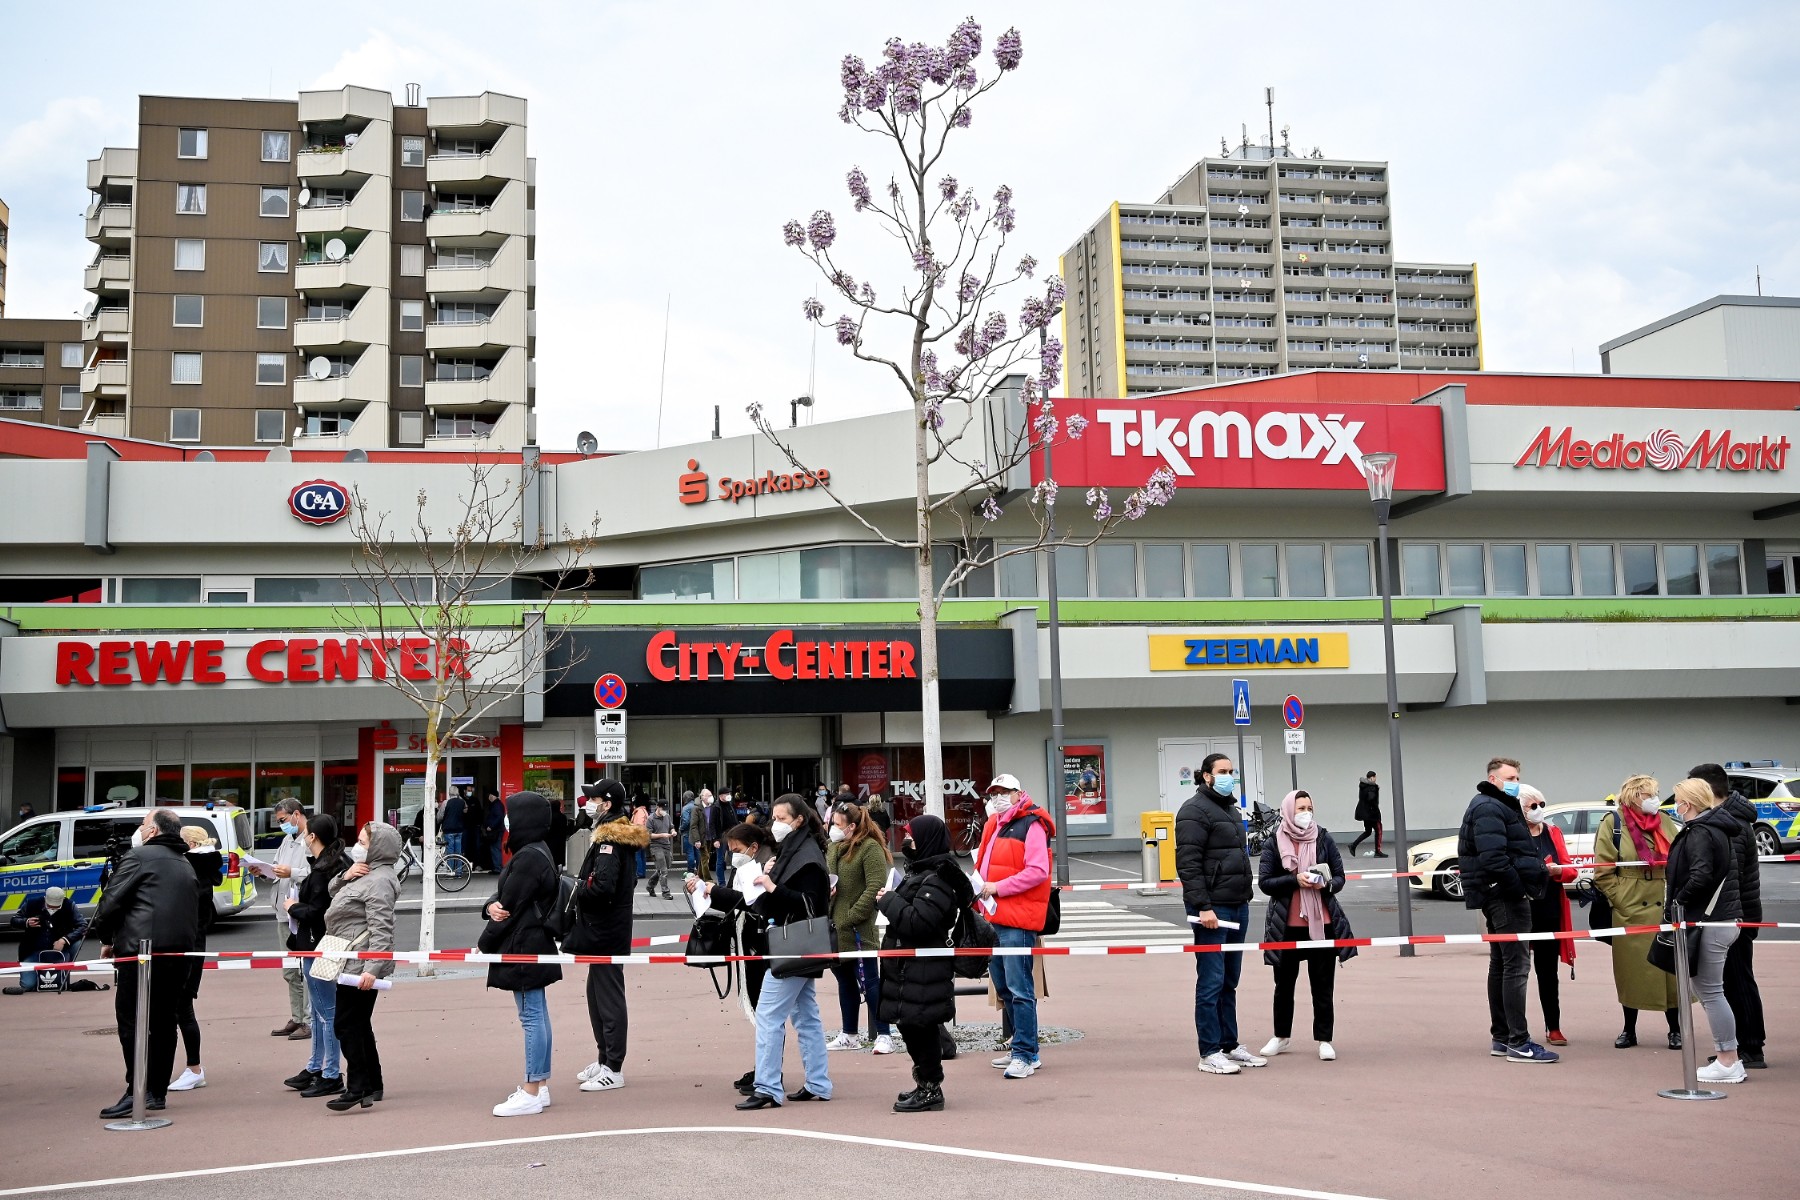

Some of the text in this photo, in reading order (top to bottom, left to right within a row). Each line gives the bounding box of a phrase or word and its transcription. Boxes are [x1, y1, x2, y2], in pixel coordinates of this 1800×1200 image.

[718, 468, 830, 504] Sparkasse
[300, 491, 339, 510] C&A
[55, 637, 472, 686] REWE CENTER
[1184, 638, 1320, 665] ZEEMAN
[3, 874, 49, 888] POLIZEI
